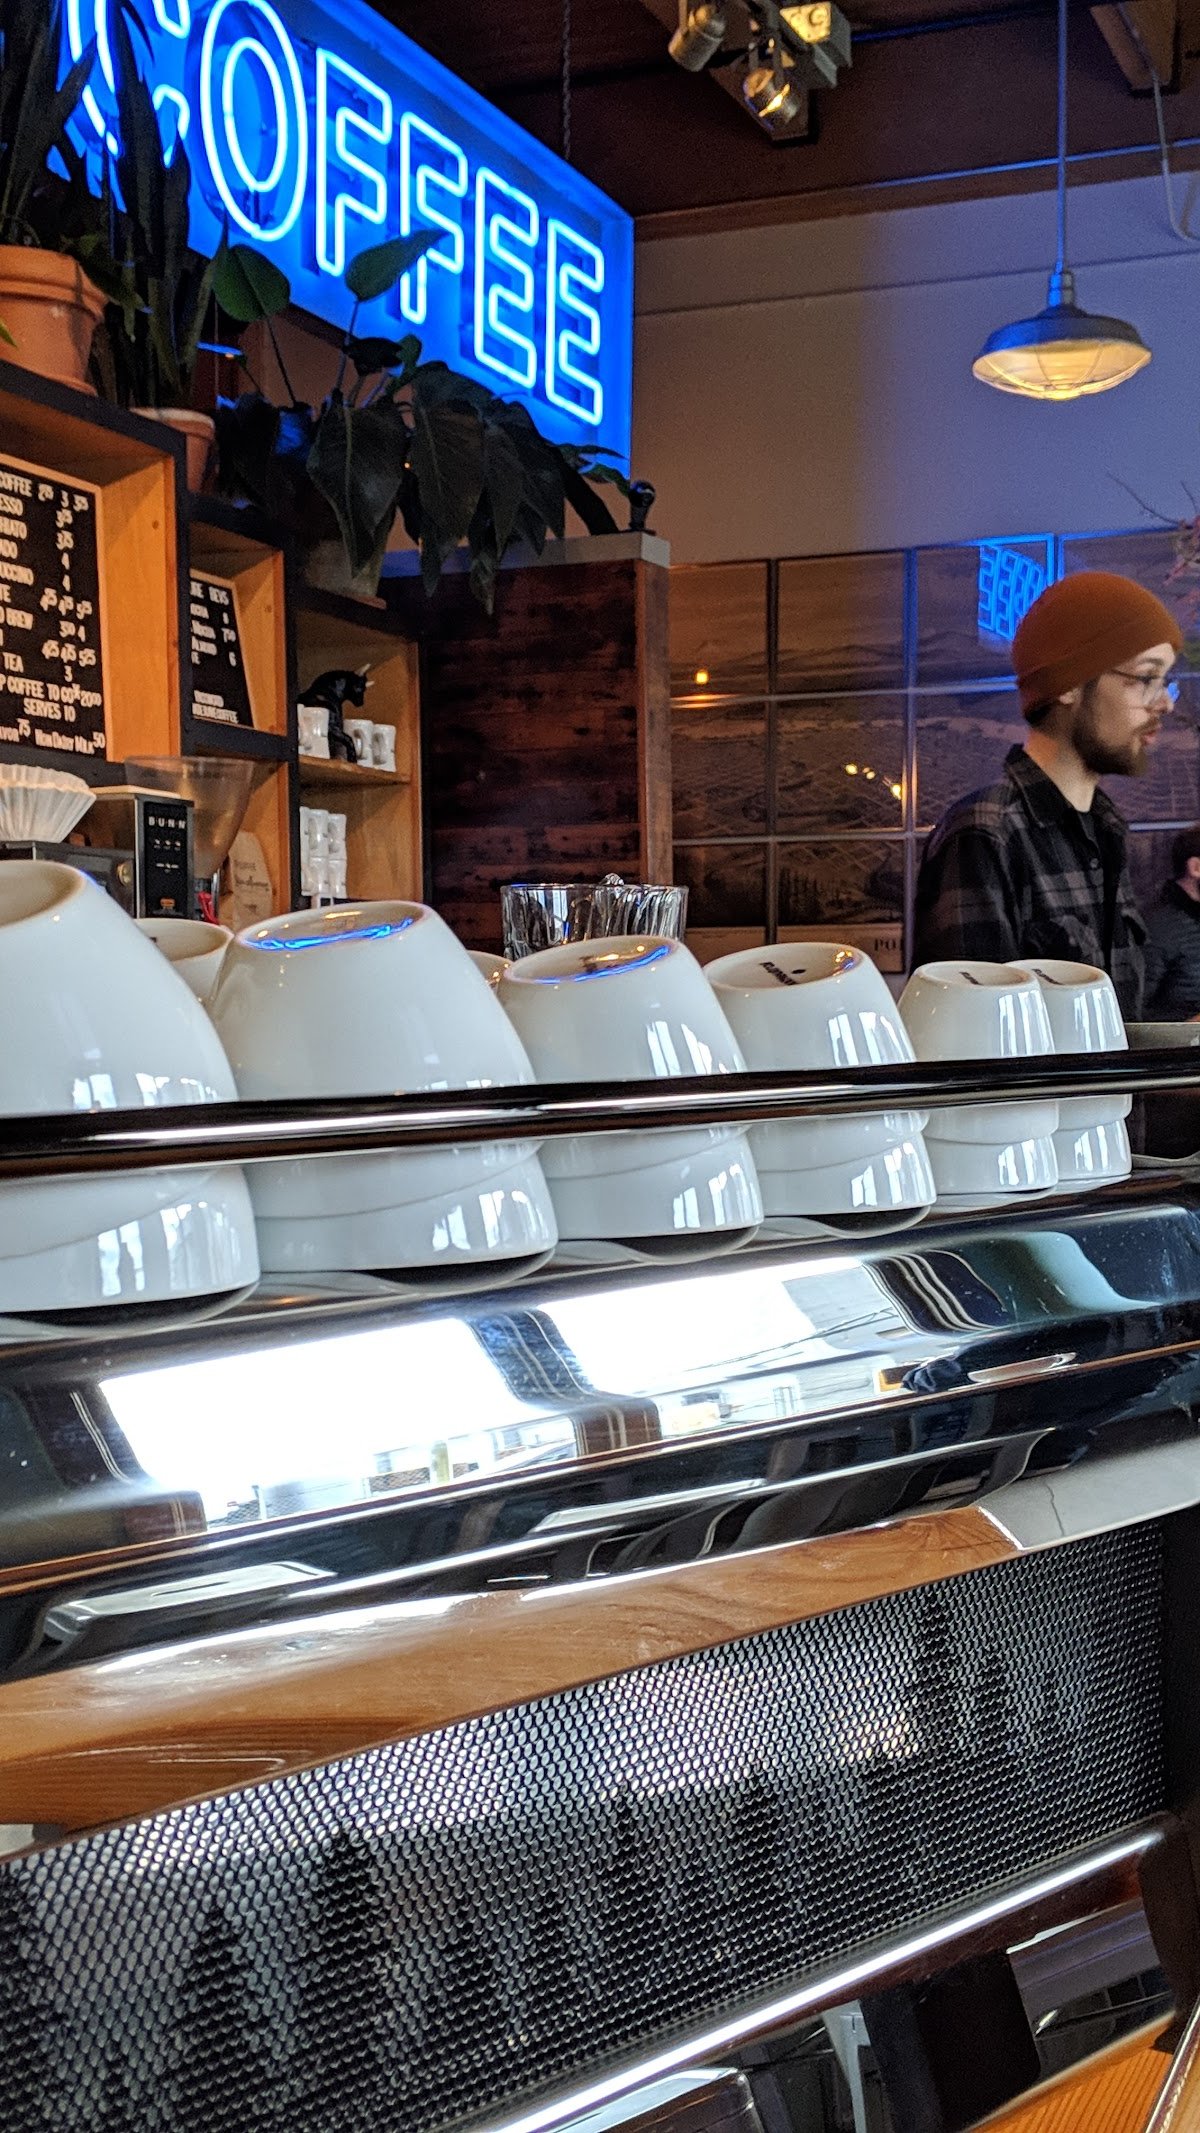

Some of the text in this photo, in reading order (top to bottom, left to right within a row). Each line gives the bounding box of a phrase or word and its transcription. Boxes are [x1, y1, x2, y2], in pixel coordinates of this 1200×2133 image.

[2, 652, 24, 674] TEA
[7, 675, 45, 699] COFFEE
[46, 683, 60, 702] TO
[23, 697, 77, 723] SERVES 10
[148, 816, 186, 829] BUNN
